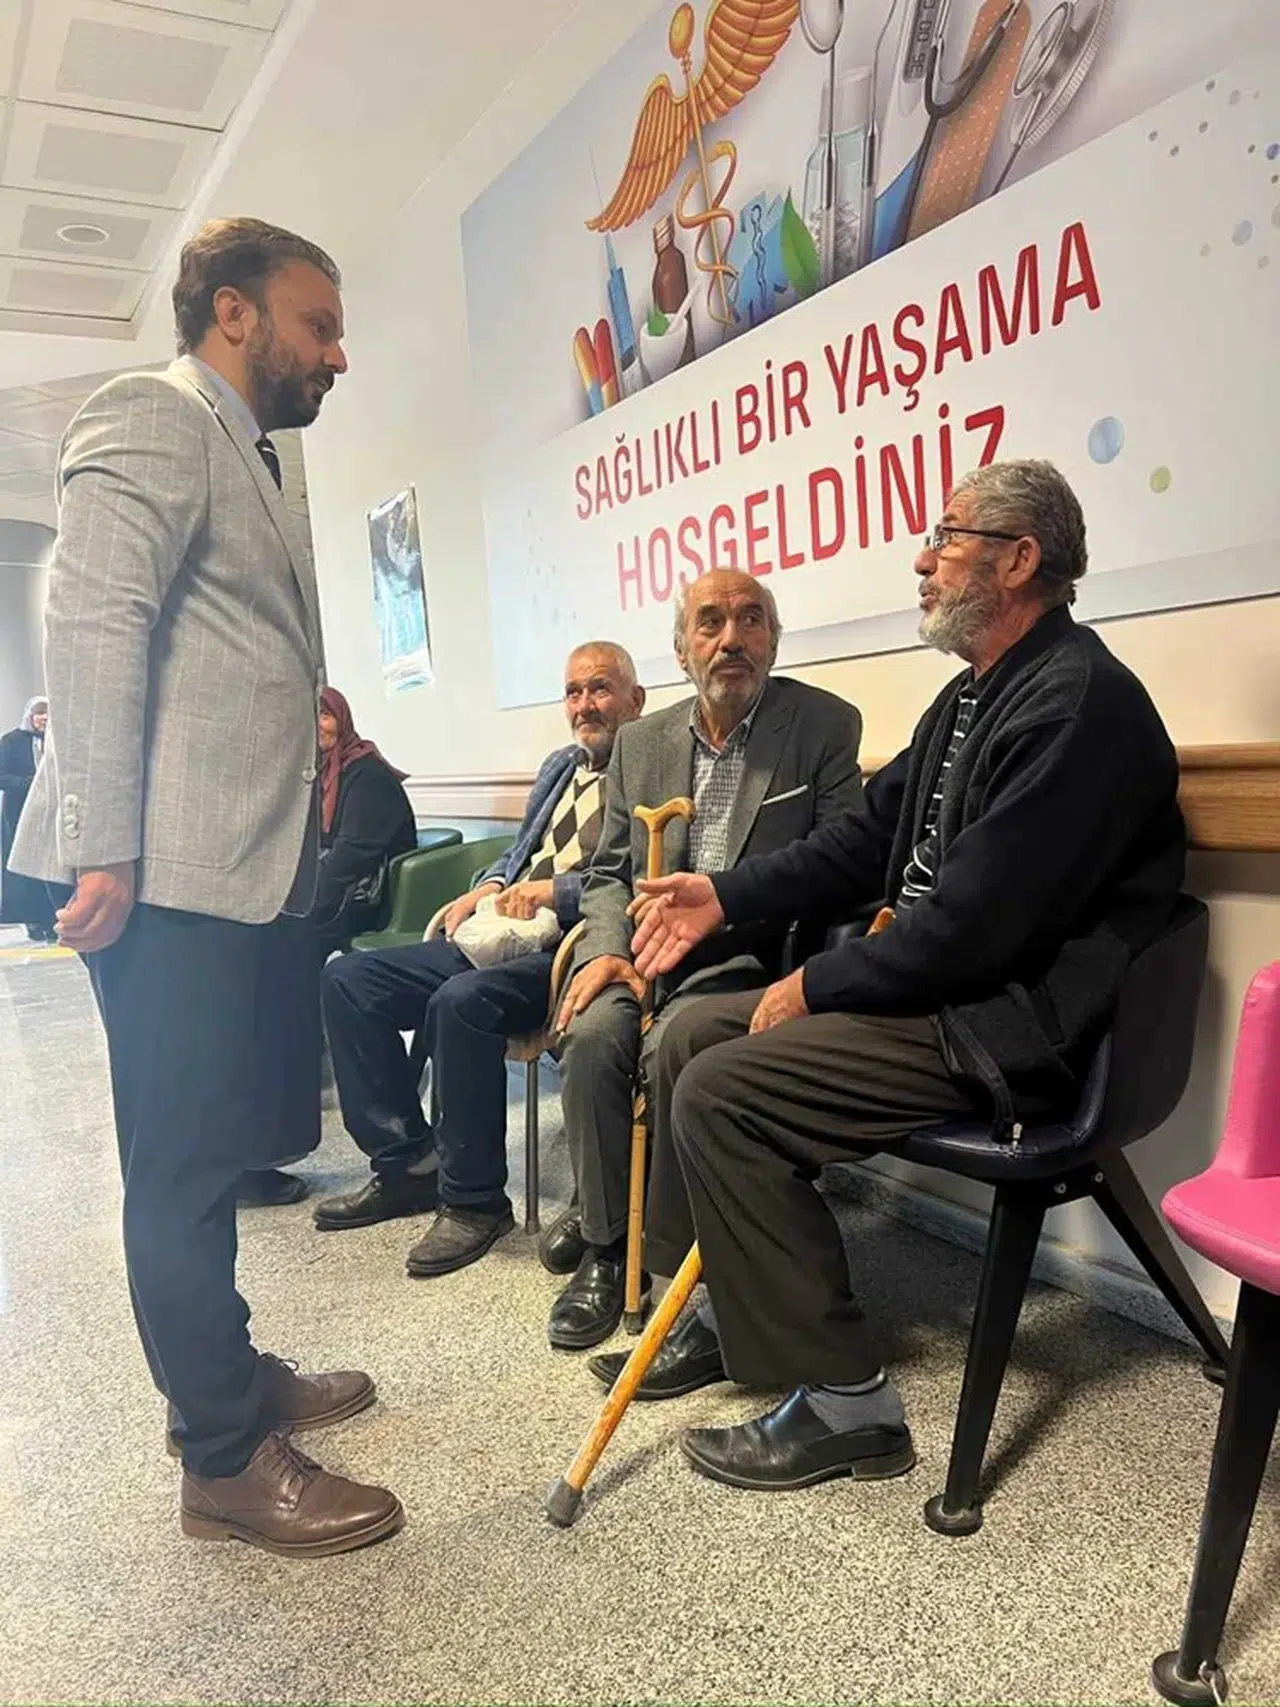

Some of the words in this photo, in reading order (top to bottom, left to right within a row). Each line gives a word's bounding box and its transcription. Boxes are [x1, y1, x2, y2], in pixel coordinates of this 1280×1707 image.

[575, 400, 721, 521] SAĞLIKLI
[734, 359, 812, 456] BİR
[823, 221, 1101, 412] YAŞAMA
